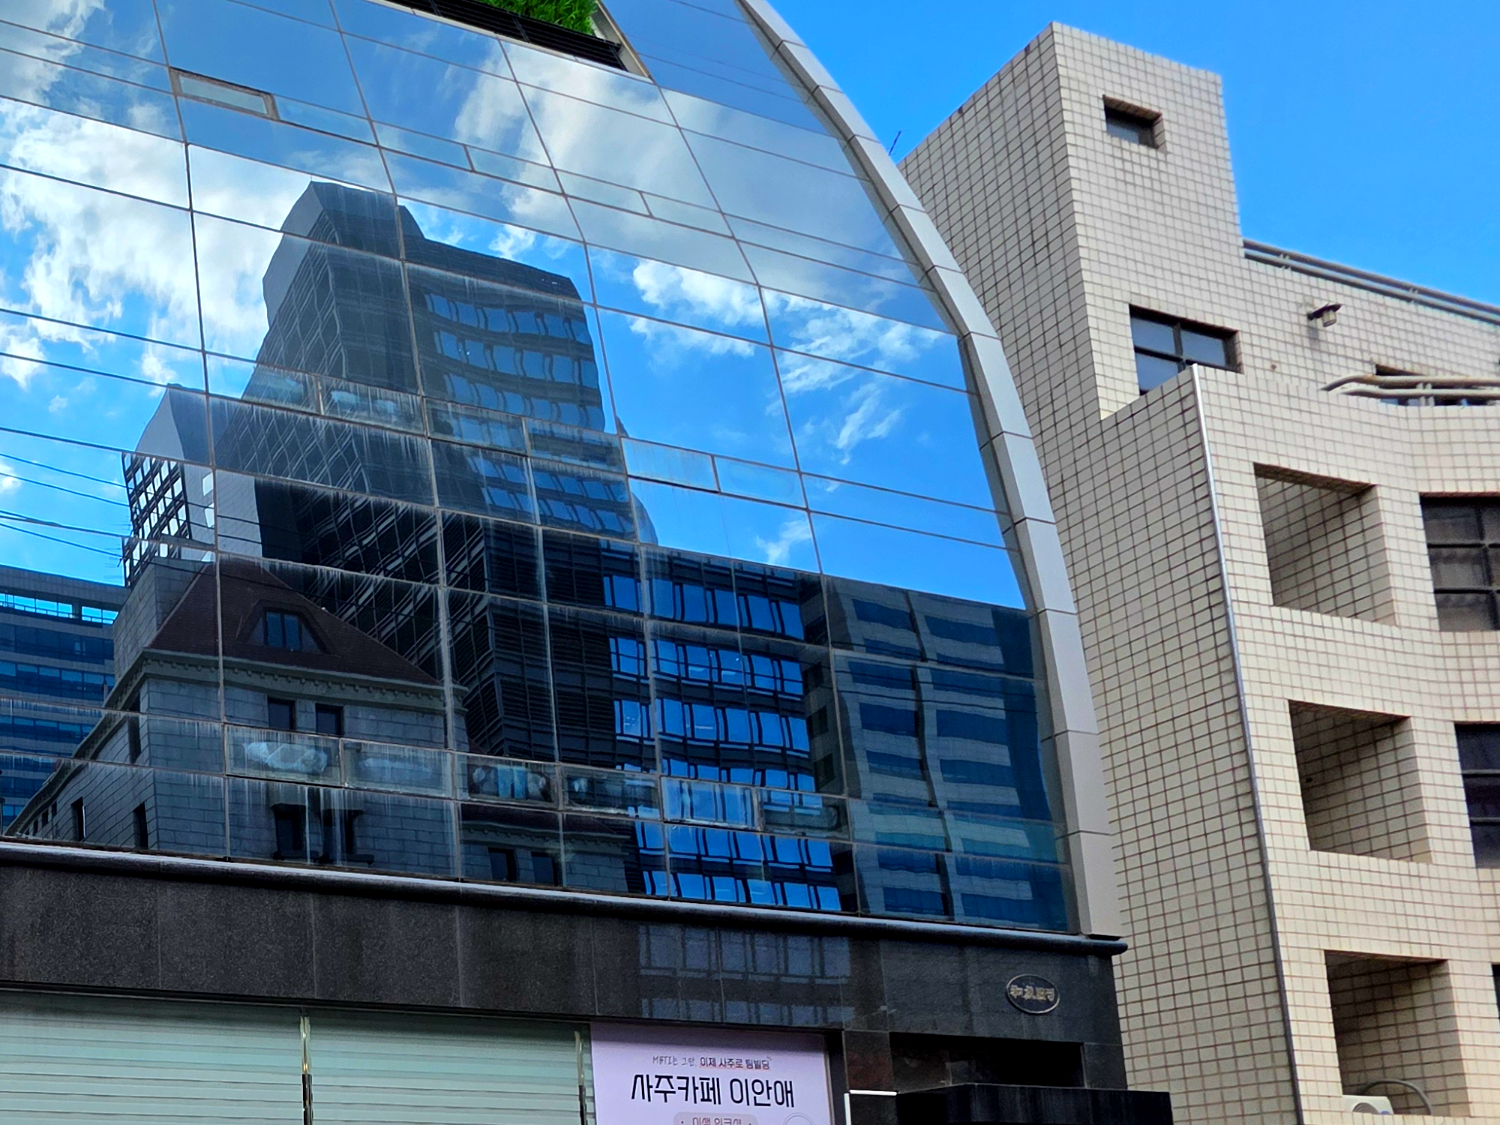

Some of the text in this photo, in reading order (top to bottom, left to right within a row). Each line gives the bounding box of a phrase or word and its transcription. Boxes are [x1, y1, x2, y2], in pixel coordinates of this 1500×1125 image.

[699, 1056, 717, 1068] 이제
[718, 1057, 744, 1069] 사주로
[631, 1073, 795, 1108] 사주카페 이안애
